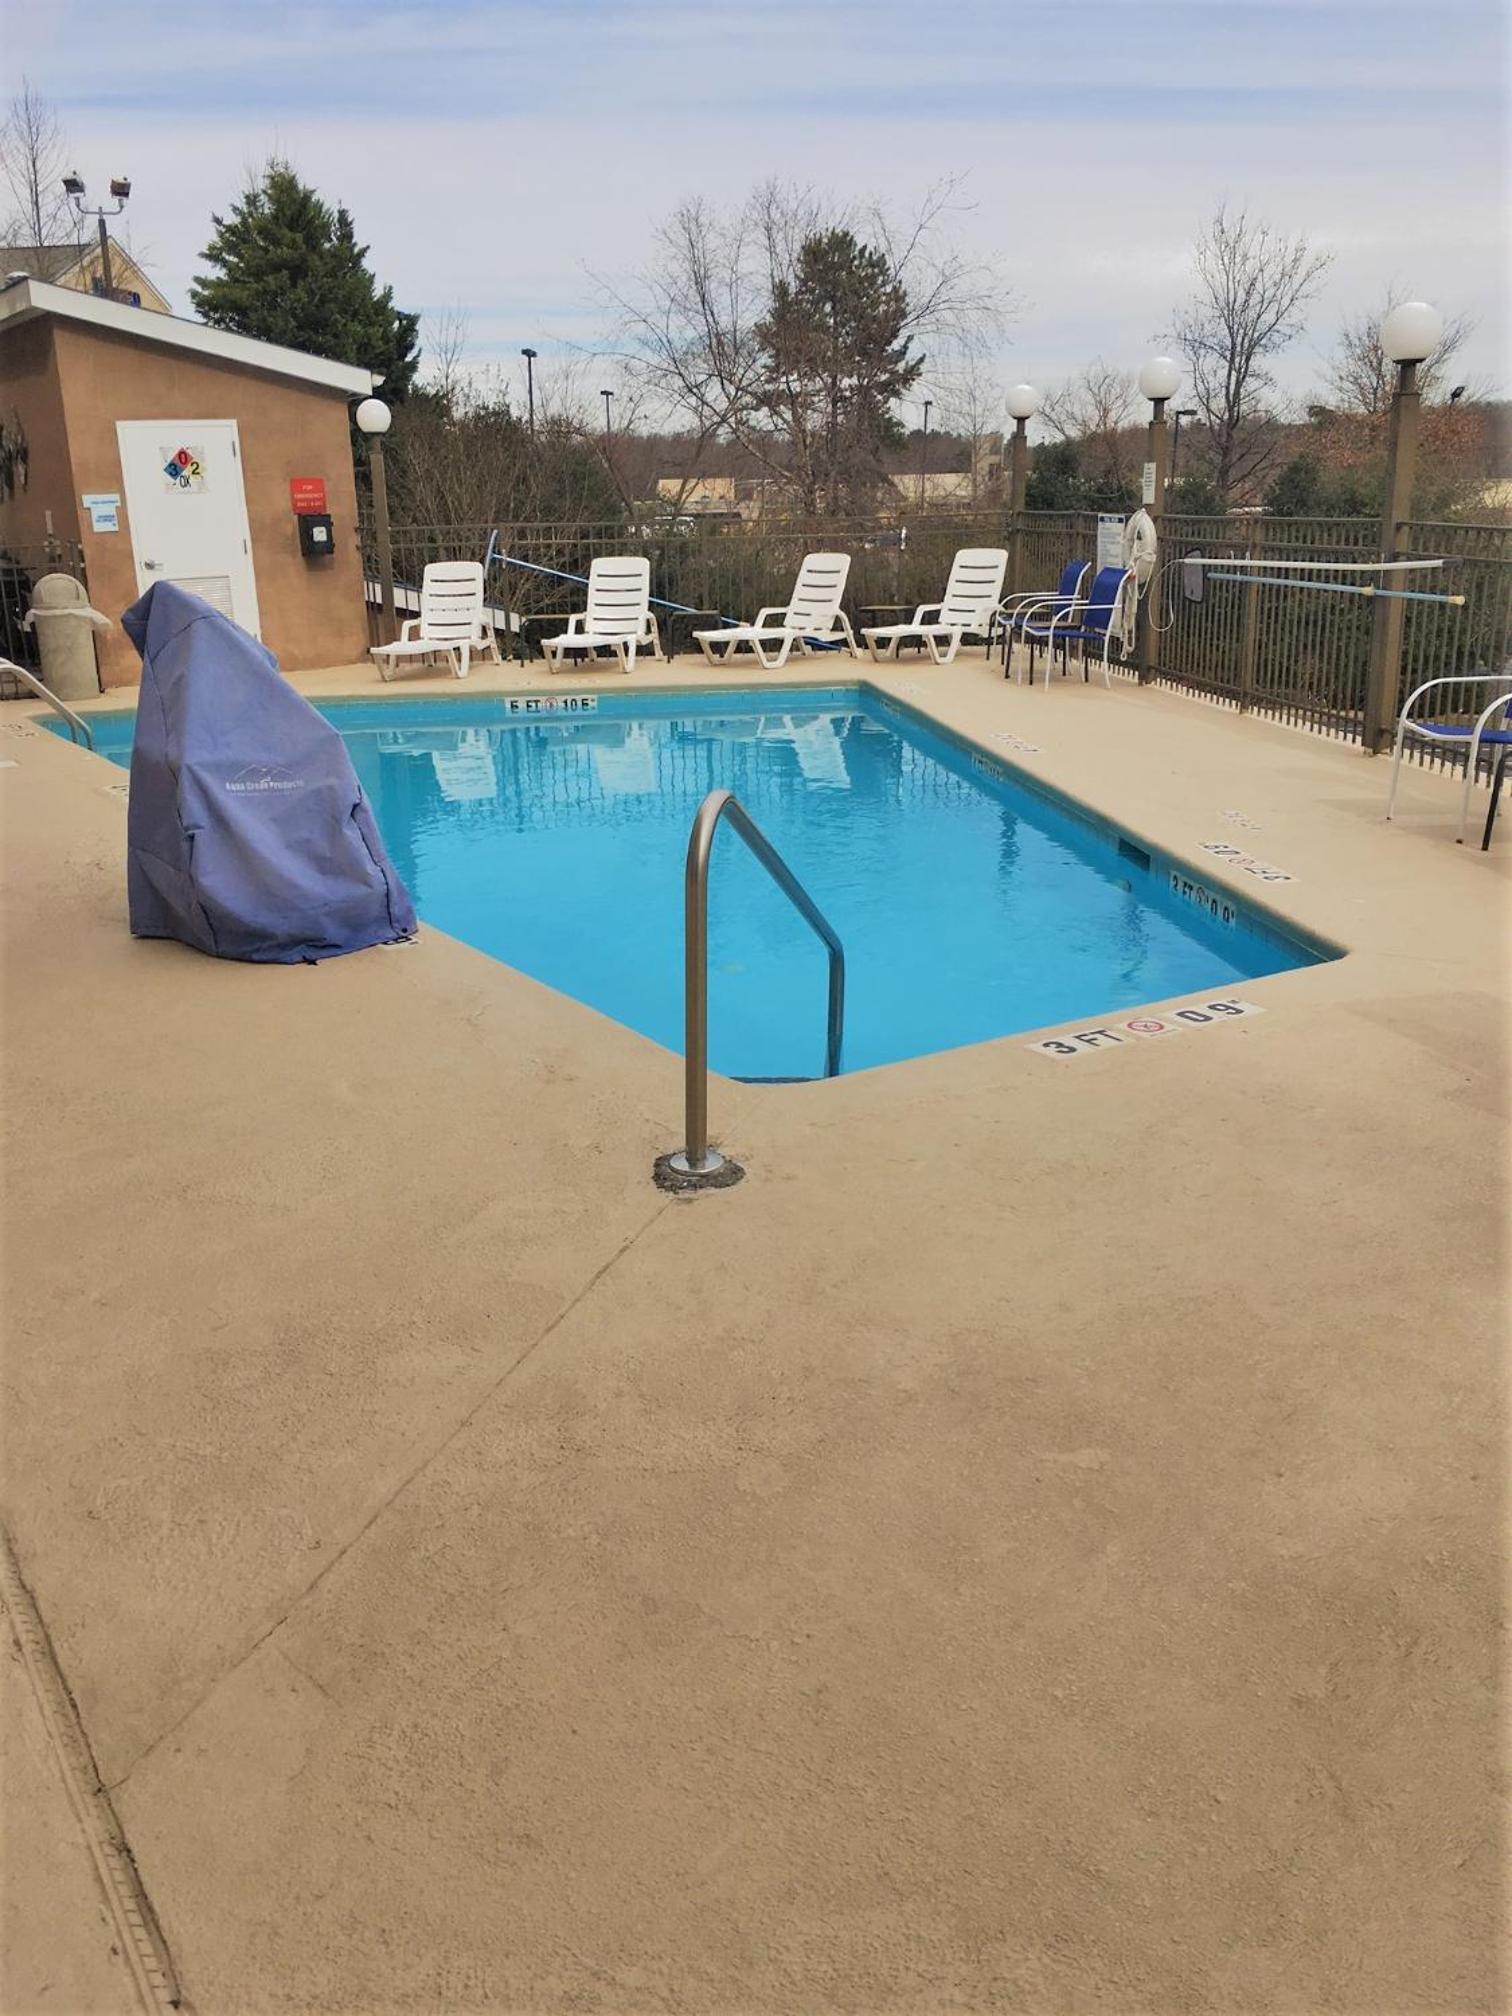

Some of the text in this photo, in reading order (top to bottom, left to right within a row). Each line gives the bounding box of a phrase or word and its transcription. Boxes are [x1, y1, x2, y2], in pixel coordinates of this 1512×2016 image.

[178, 451, 188, 465] 0
[168, 461, 201, 476] 3 2
[1042, 1040, 1078, 1055] 3
[1072, 1029, 1124, 1047] FT
